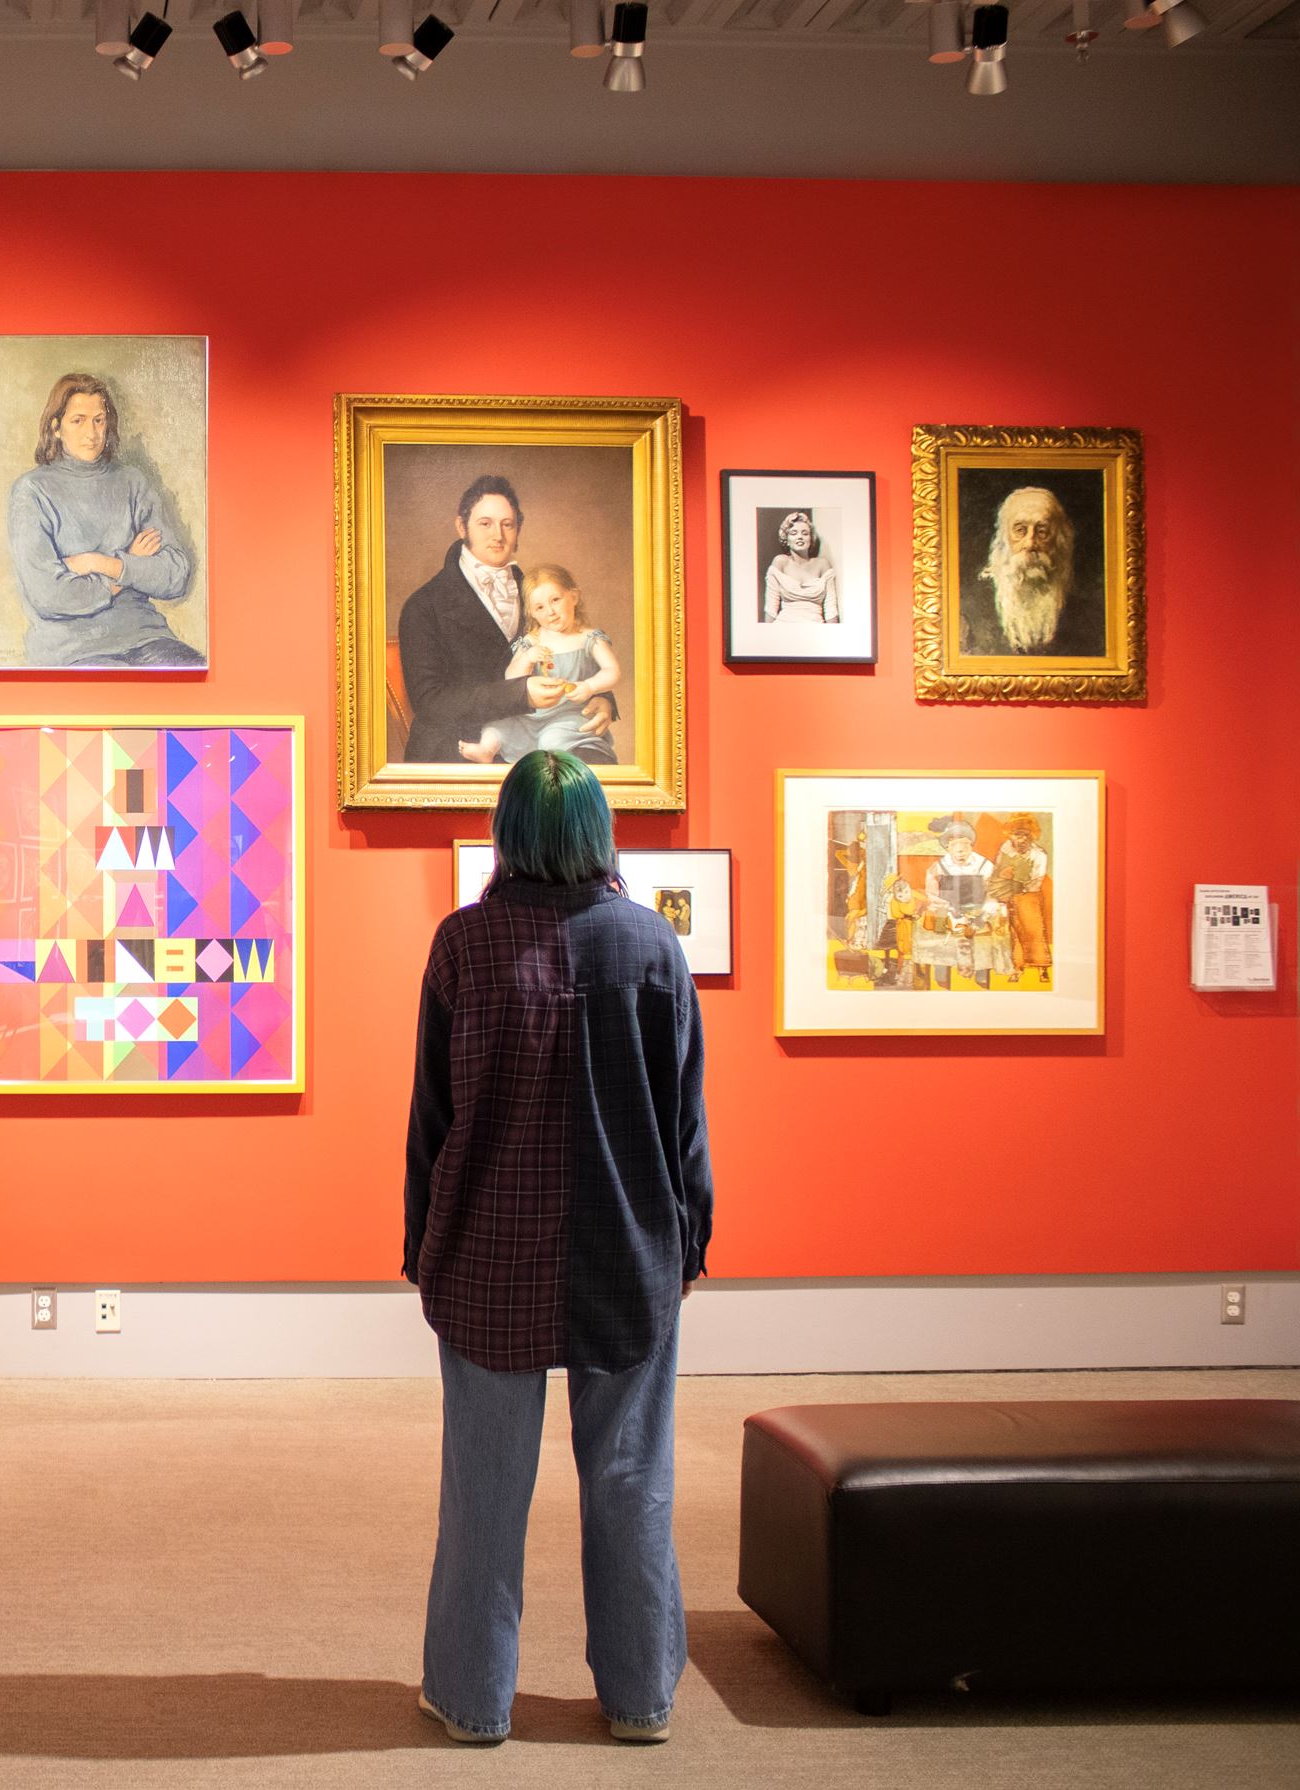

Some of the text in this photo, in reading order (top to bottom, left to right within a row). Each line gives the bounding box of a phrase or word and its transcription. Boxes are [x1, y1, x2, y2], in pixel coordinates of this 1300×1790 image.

[95, 826, 175, 870] AM
[115, 882, 156, 927] A
[74, 997, 198, 1042] TOO
